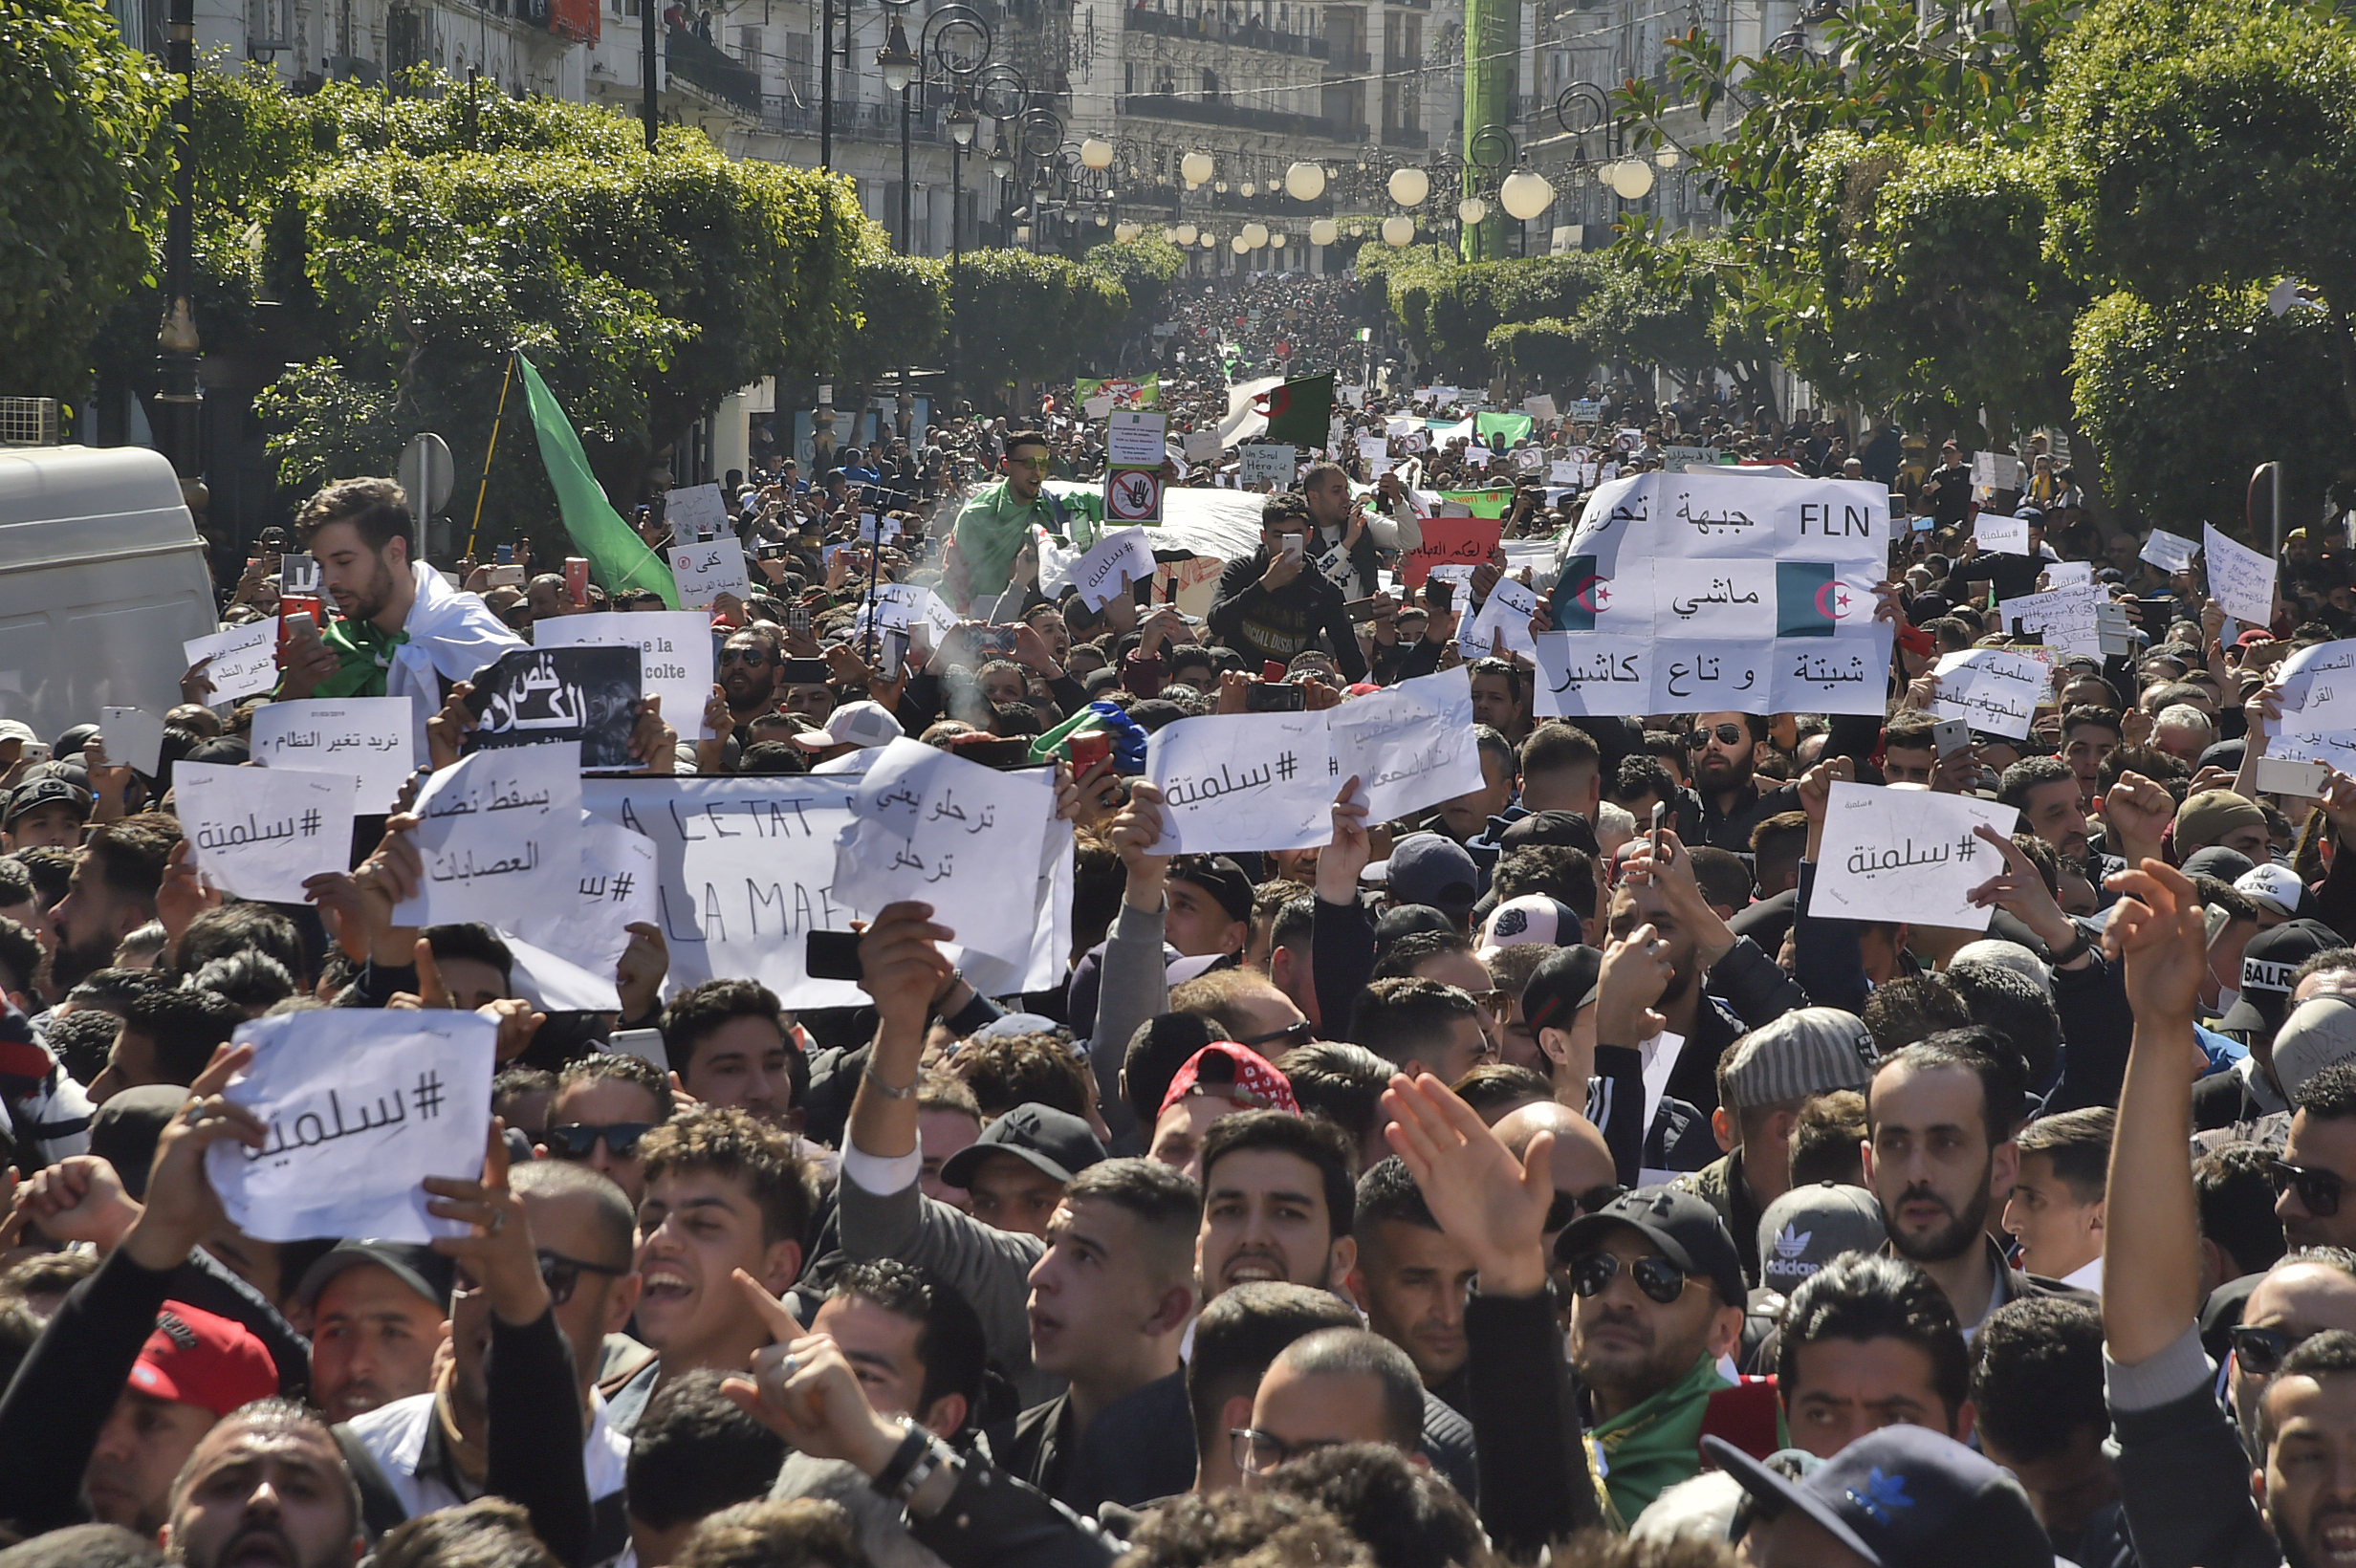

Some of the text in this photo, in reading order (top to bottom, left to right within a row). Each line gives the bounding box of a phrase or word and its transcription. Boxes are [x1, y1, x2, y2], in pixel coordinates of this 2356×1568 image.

[1245, 449, 1278, 460] Un Seul
[1135, 494, 1143, 504] 5
[1674, 491, 1756, 535] جبهة
[1800, 503, 1870, 538] FLN
[695, 551, 722, 574] كفى
[905, 591, 918, 608] لا
[1672, 577, 1760, 621] ماشي
[229, 633, 267, 655] الشعب
[657, 638, 673, 653] la
[644, 663, 687, 680] colte
[1548, 652, 1864, 697] شيتة و تاع كاشير
[1985, 656, 2036, 684] سلمية
[2310, 653, 2355, 676] الشعب
[477, 681, 588, 734] الكلام
[1933, 686, 2028, 719] سلمية سلمي
[2296, 686, 2334, 710] القرار
[275, 730, 399, 754] نريد تغير النظام
[486, 779, 550, 815] يسقط
[876, 779, 995, 834] ترحلو يعني
[622, 796, 648, 837] A
[431, 840, 538, 886] العصابات
[887, 838, 953, 883] ترحلو
[2239, 882, 2280, 895] KING
[661, 882, 728, 943] LA
[746, 877, 859, 941] MAF
[1766, 1258, 1821, 1276] adidas
